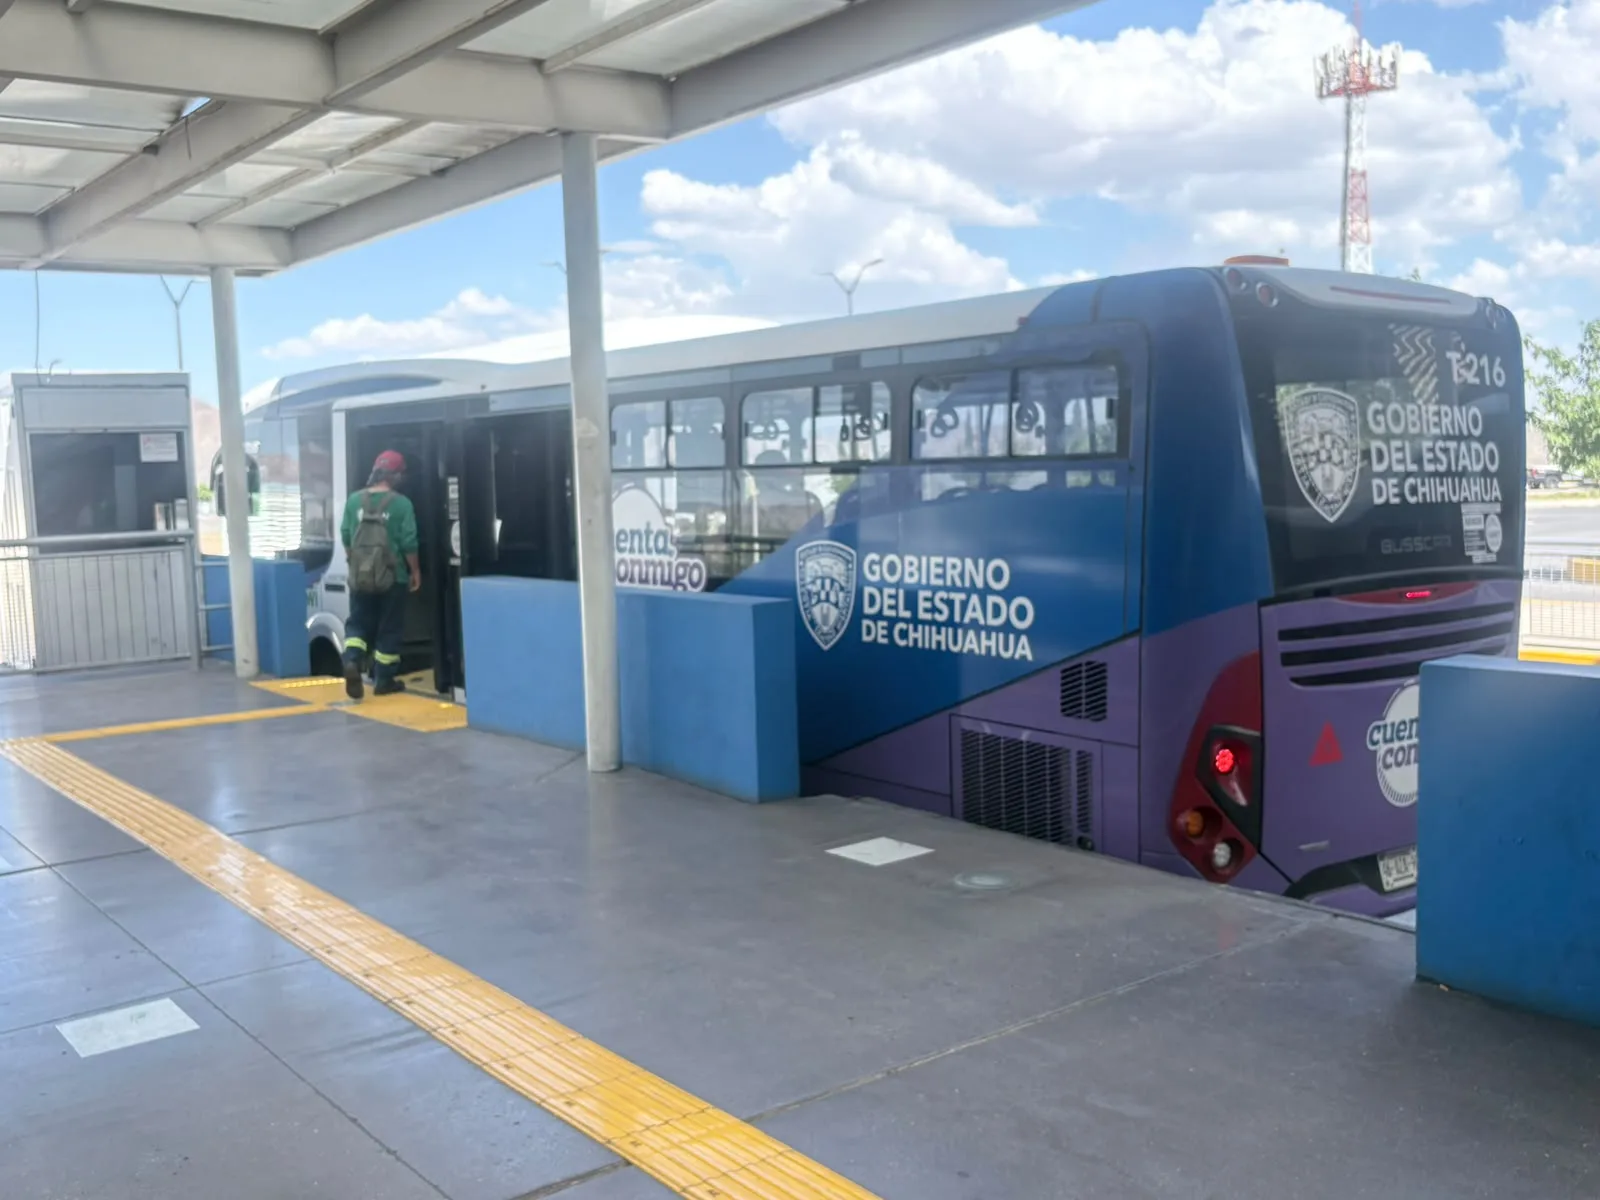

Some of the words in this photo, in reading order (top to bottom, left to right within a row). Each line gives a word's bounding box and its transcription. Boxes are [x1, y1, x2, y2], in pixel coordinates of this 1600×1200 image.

[1367, 401, 1483, 437] GOBIERNO
[1370, 440, 1418, 472] DEL
[1421, 440, 1500, 473] ESTADO
[1372, 478, 1401, 505] DE
[1403, 477, 1502, 504] CHIHUAHUA
[863, 552, 1011, 591] GOBIERNO
[863, 586, 912, 618] DEL
[917, 589, 1035, 630] ESTADO
[861, 619, 889, 644] DE
[893, 622, 1033, 662] CHIHUAHUA
